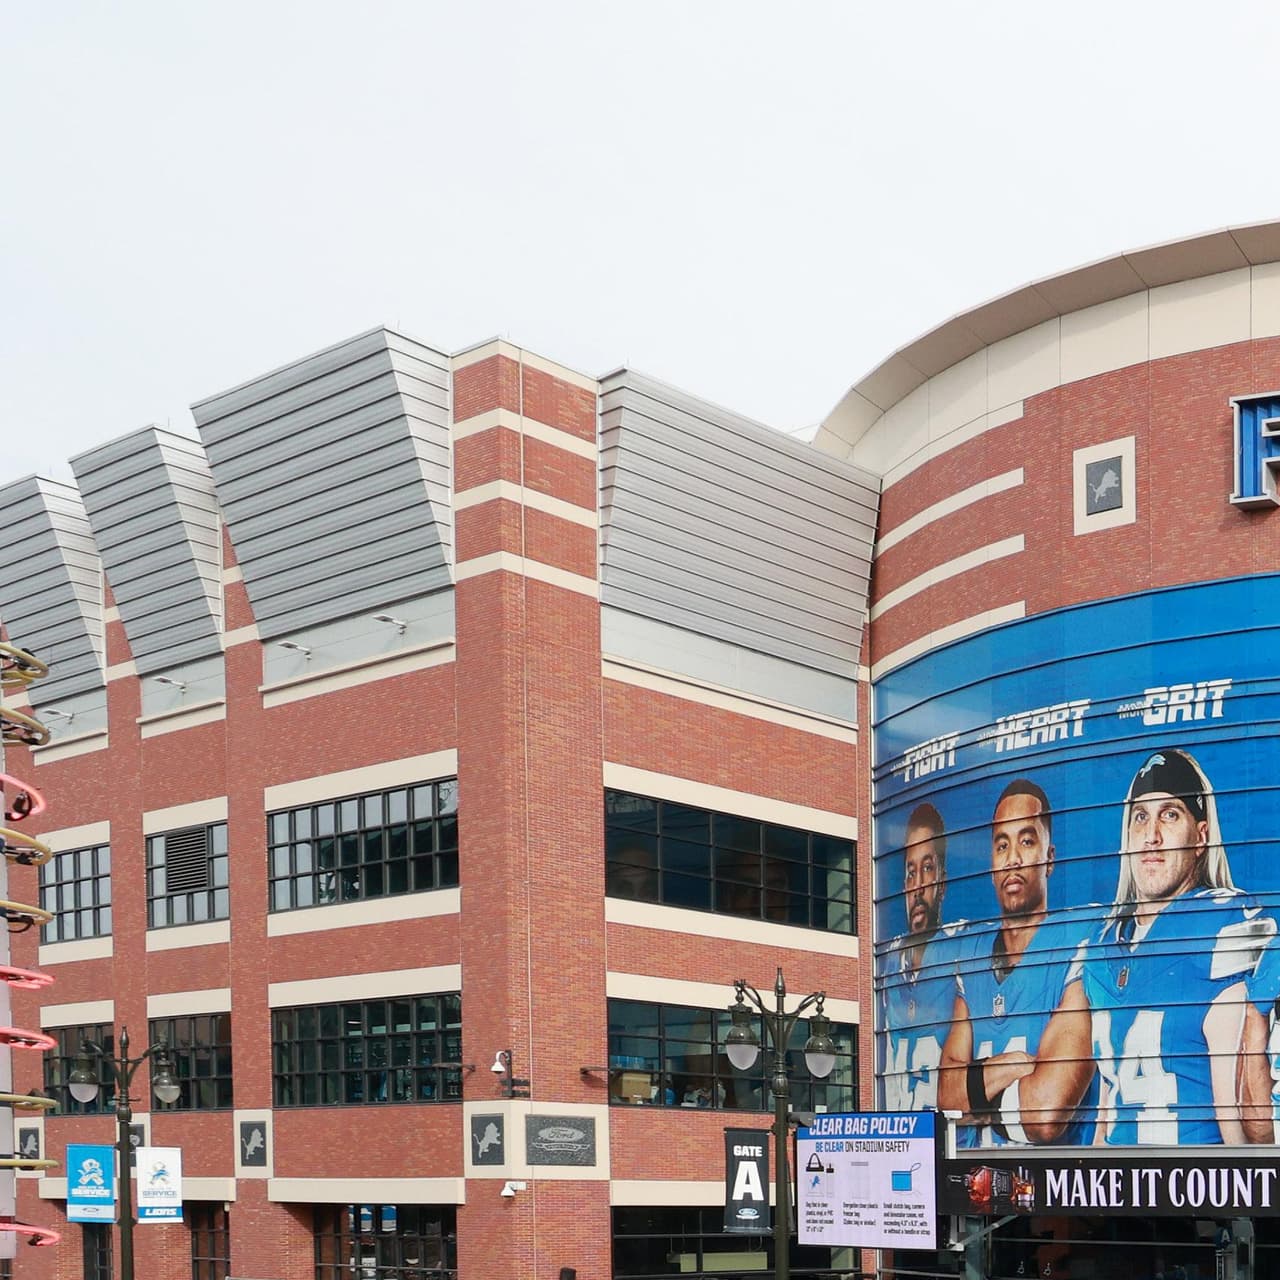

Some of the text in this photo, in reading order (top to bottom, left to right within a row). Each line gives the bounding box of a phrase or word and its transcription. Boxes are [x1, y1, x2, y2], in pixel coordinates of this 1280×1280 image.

[1141, 679, 1233, 726] GRIT
[994, 699, 1092, 753] HEART
[902, 730, 961, 783] FIGHT
[844, 1117, 868, 1135] BAG
[870, 1116, 917, 1135] POLICY
[733, 1145, 763, 1157] GATE
[815, 1141, 910, 1152] BE CLEAR ON STADIUM SAFETY
[732, 1160, 765, 1201] A
[1045, 1168, 1125, 1210] MAKE
[1131, 1168, 1163, 1210] IT
[1168, 1168, 1277, 1209] COUNT
